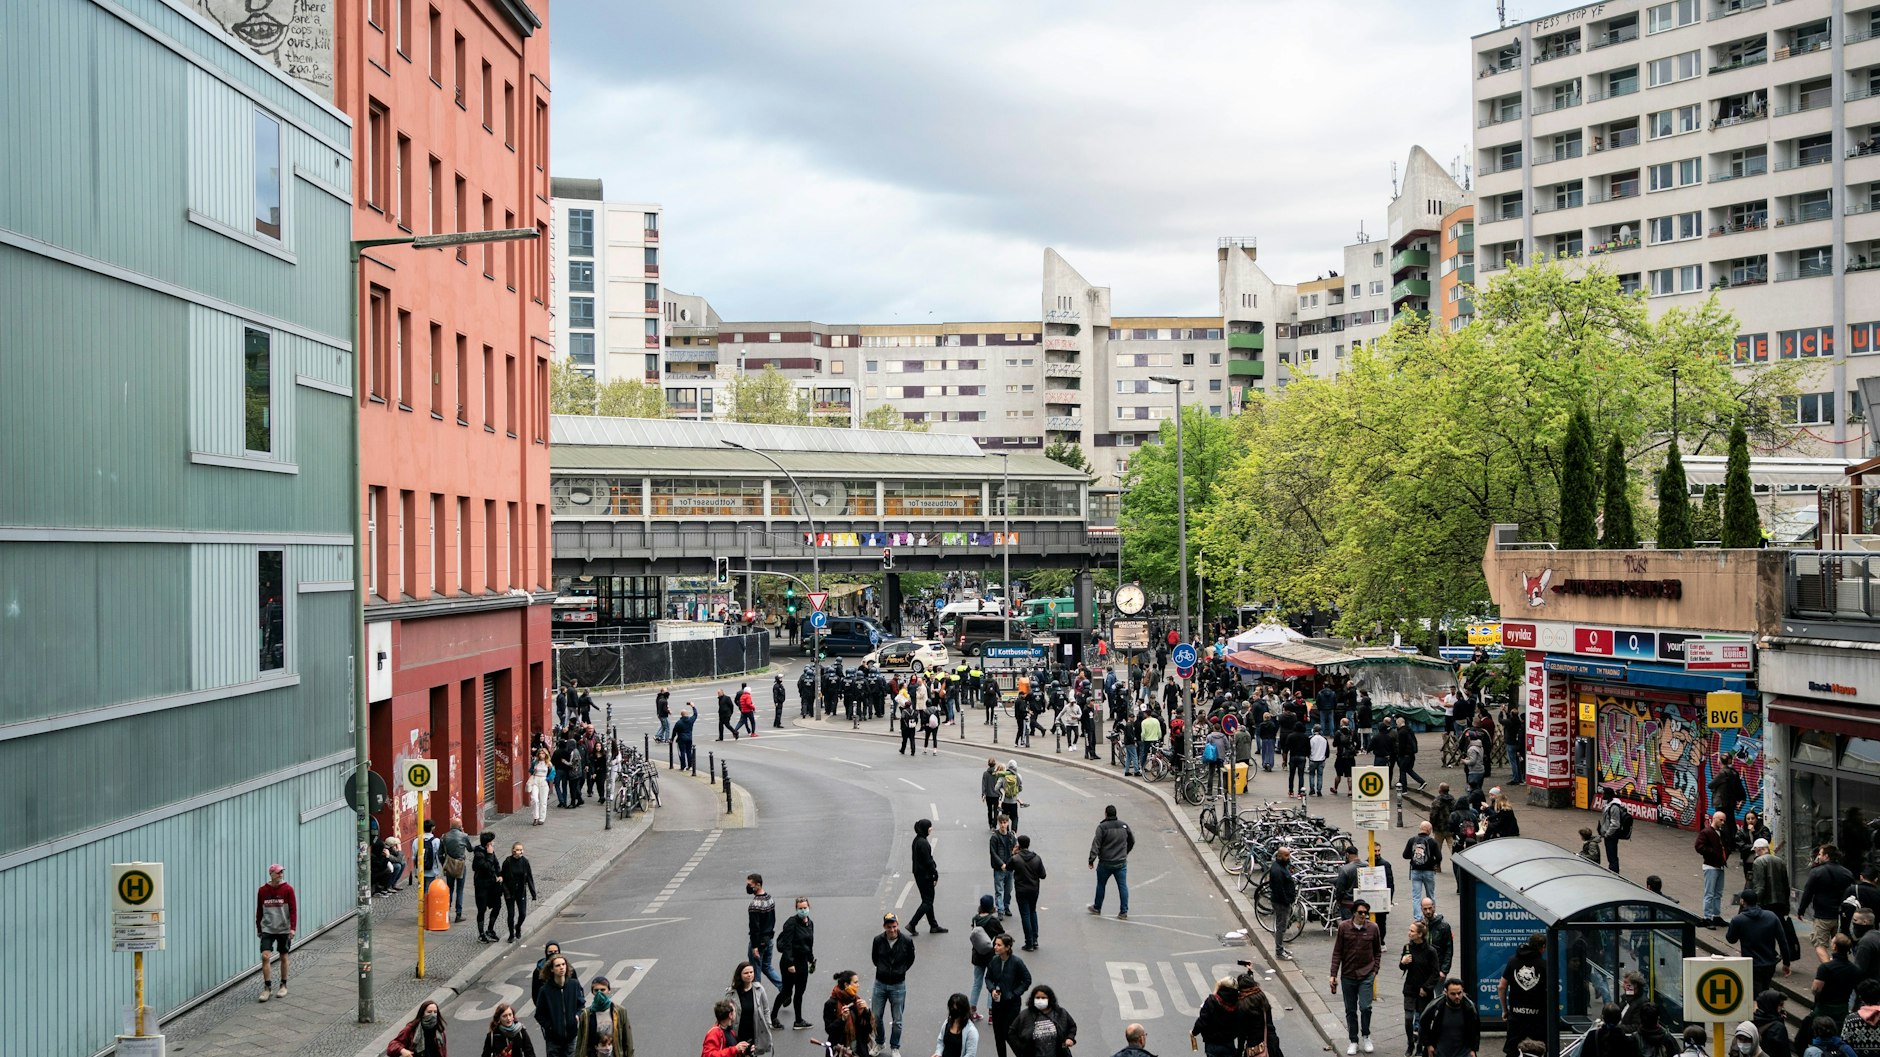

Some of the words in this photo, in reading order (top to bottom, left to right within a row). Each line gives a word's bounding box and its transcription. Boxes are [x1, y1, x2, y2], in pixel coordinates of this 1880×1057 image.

[1784, 329, 1880, 354] SCHU
[987, 648, 995, 656] U
[1667, 641, 1685, 653] yourf
[1711, 710, 1738, 724] BVG
[413, 769, 424, 782] H
[1365, 777, 1377, 791] H
[127, 878, 144, 897] H
[1479, 911, 1503, 921] UND
[1505, 911, 1538, 921] HUNG
[1709, 978, 1732, 1004] H
